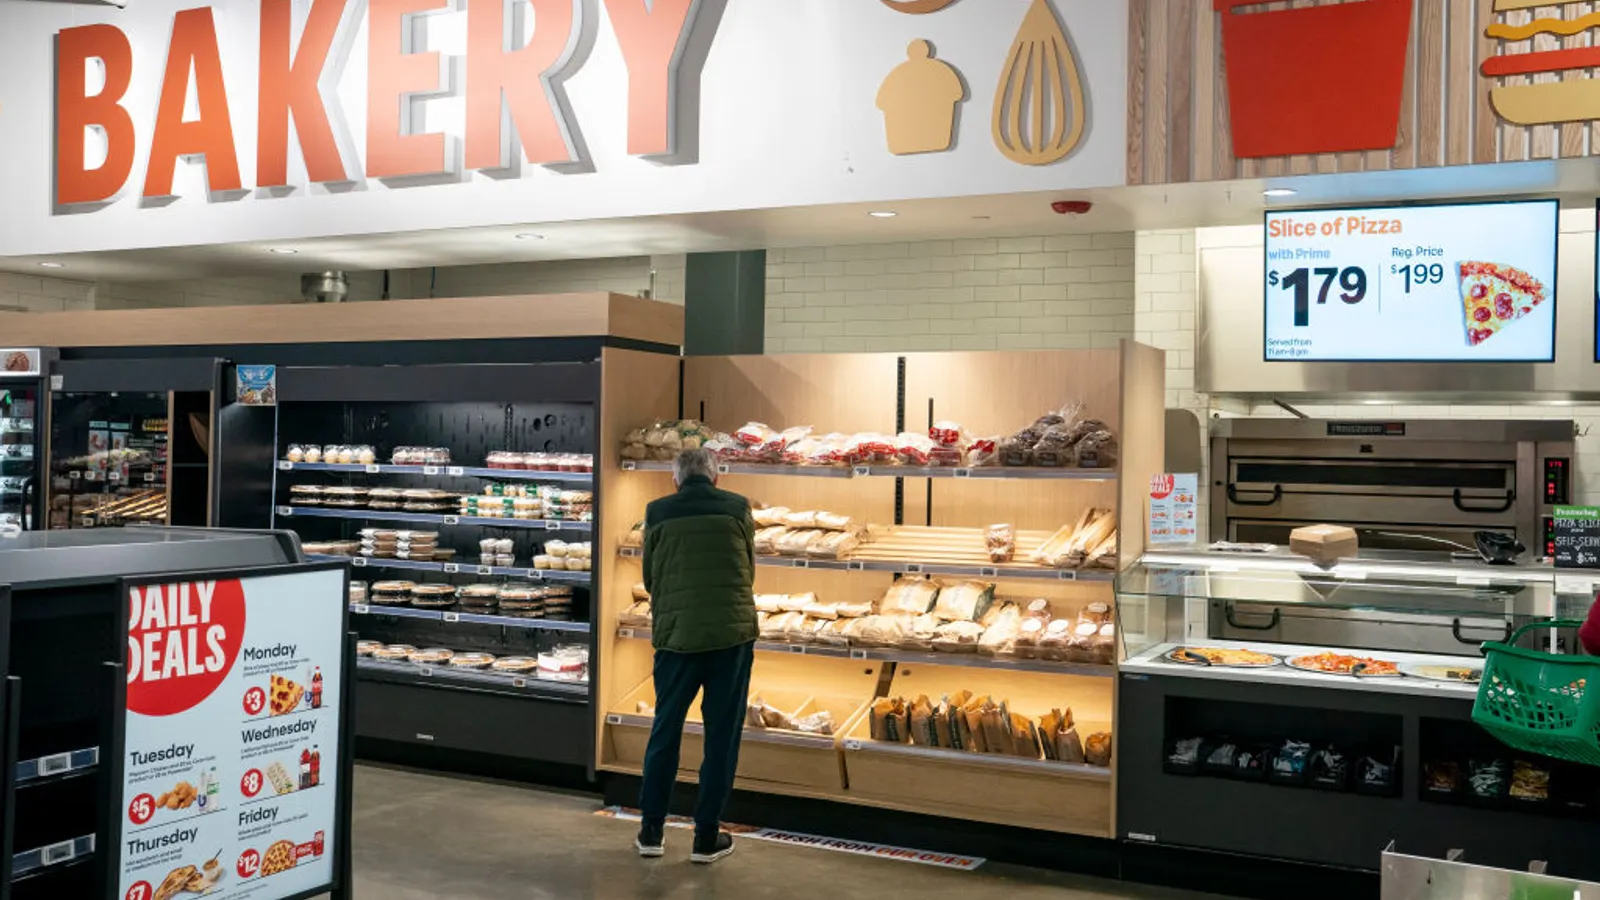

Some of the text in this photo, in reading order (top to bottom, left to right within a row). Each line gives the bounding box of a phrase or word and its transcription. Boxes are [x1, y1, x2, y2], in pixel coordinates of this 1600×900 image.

[55, 0, 710, 208] BAKERY
[1268, 215, 1402, 238] Slice of Pizza
[1268, 248, 1331, 261] with Prime
[1391, 245, 1444, 259] Reg. Price
[1391, 263, 1444, 293] $199
[1268, 265, 1367, 326] $179
[128, 580, 217, 631] DAILY
[127, 624, 227, 685] DEALS
[243, 642, 297, 660] Monday
[246, 689, 261, 712] $3
[241, 719, 317, 744] Wednesday
[130, 744, 195, 766] Tuesday
[243, 772, 259, 793] $8
[132, 796, 150, 821] $5
[238, 806, 279, 826] Friday
[127, 827, 198, 855] Thursday
[761, 830, 820, 843] FRESH
[819, 839, 876, 852] FROM
[239, 853, 258, 873] $12
[129, 884, 145, 900] $7
